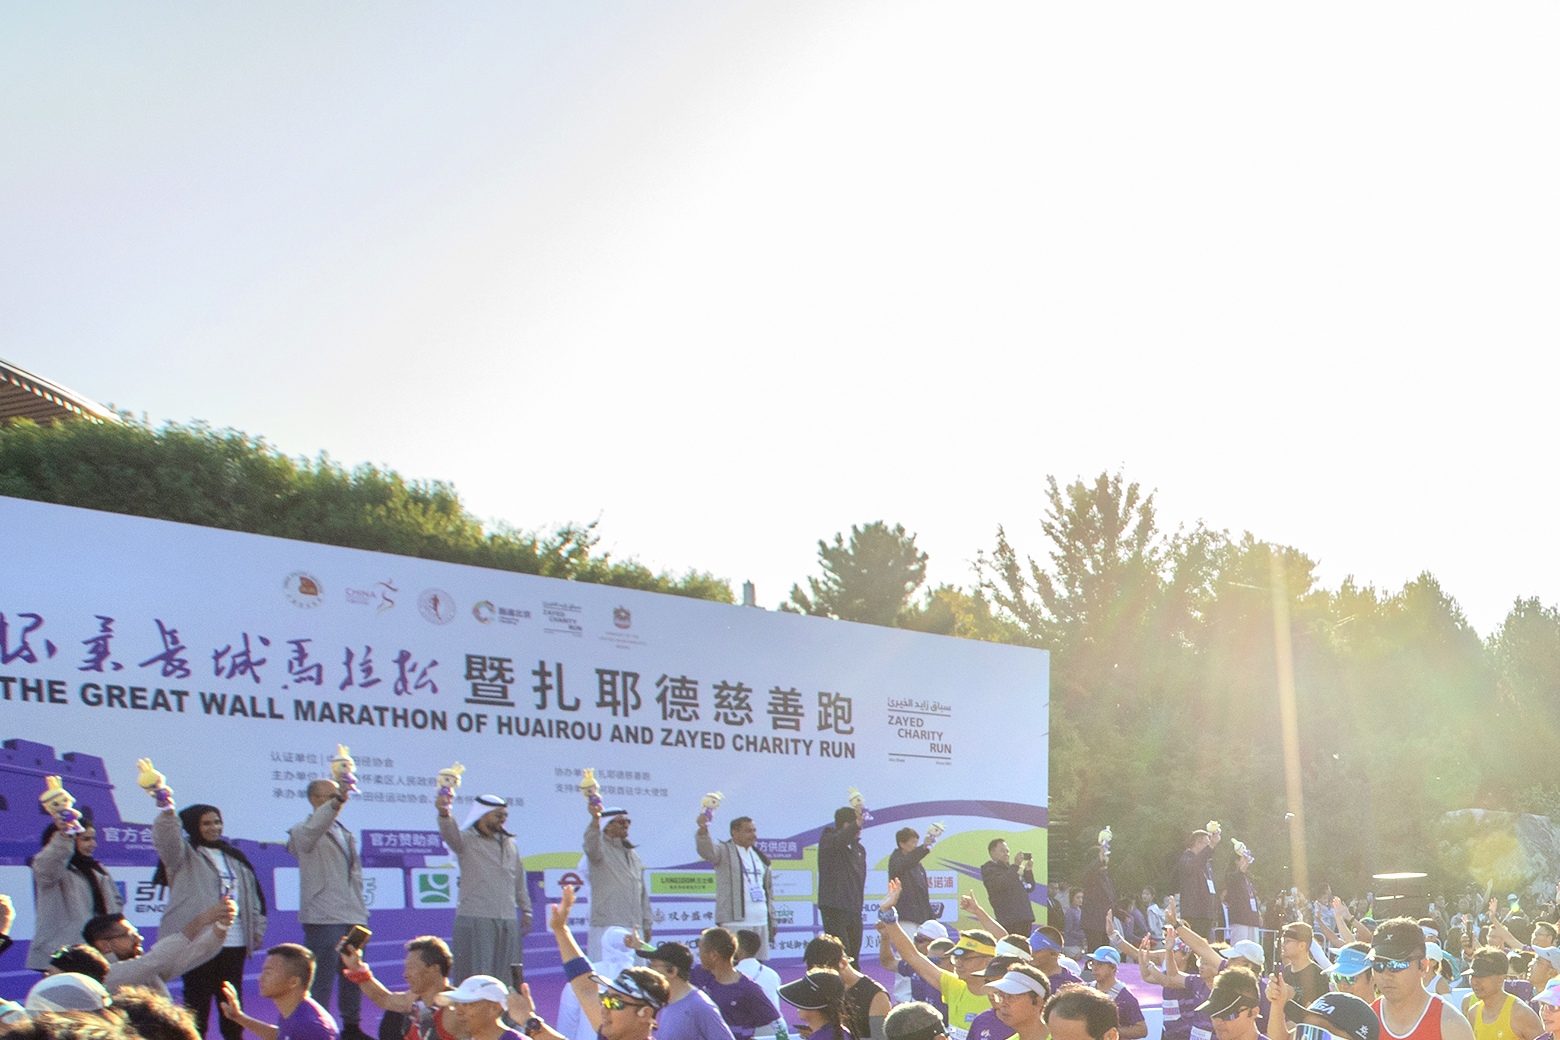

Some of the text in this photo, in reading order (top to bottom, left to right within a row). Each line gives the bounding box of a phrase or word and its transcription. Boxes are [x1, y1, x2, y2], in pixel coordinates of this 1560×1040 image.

[464, 653, 854, 736] 暨扎耶德慈善跑
[0, 676, 856, 759] THE GREAT WALL MARATHON OF HUAIROU AND ZAYED CHARITY RUN
[888, 715, 924, 728] ZAYED
[897, 728, 944, 742] CHARITY
[929, 743, 952, 755] RUN
[271, 752, 318, 764] 认证单位
[272, 770, 318, 783] 主办单位
[103, 827, 152, 843] 官方合
[369, 832, 442, 847] 官方赞助商
